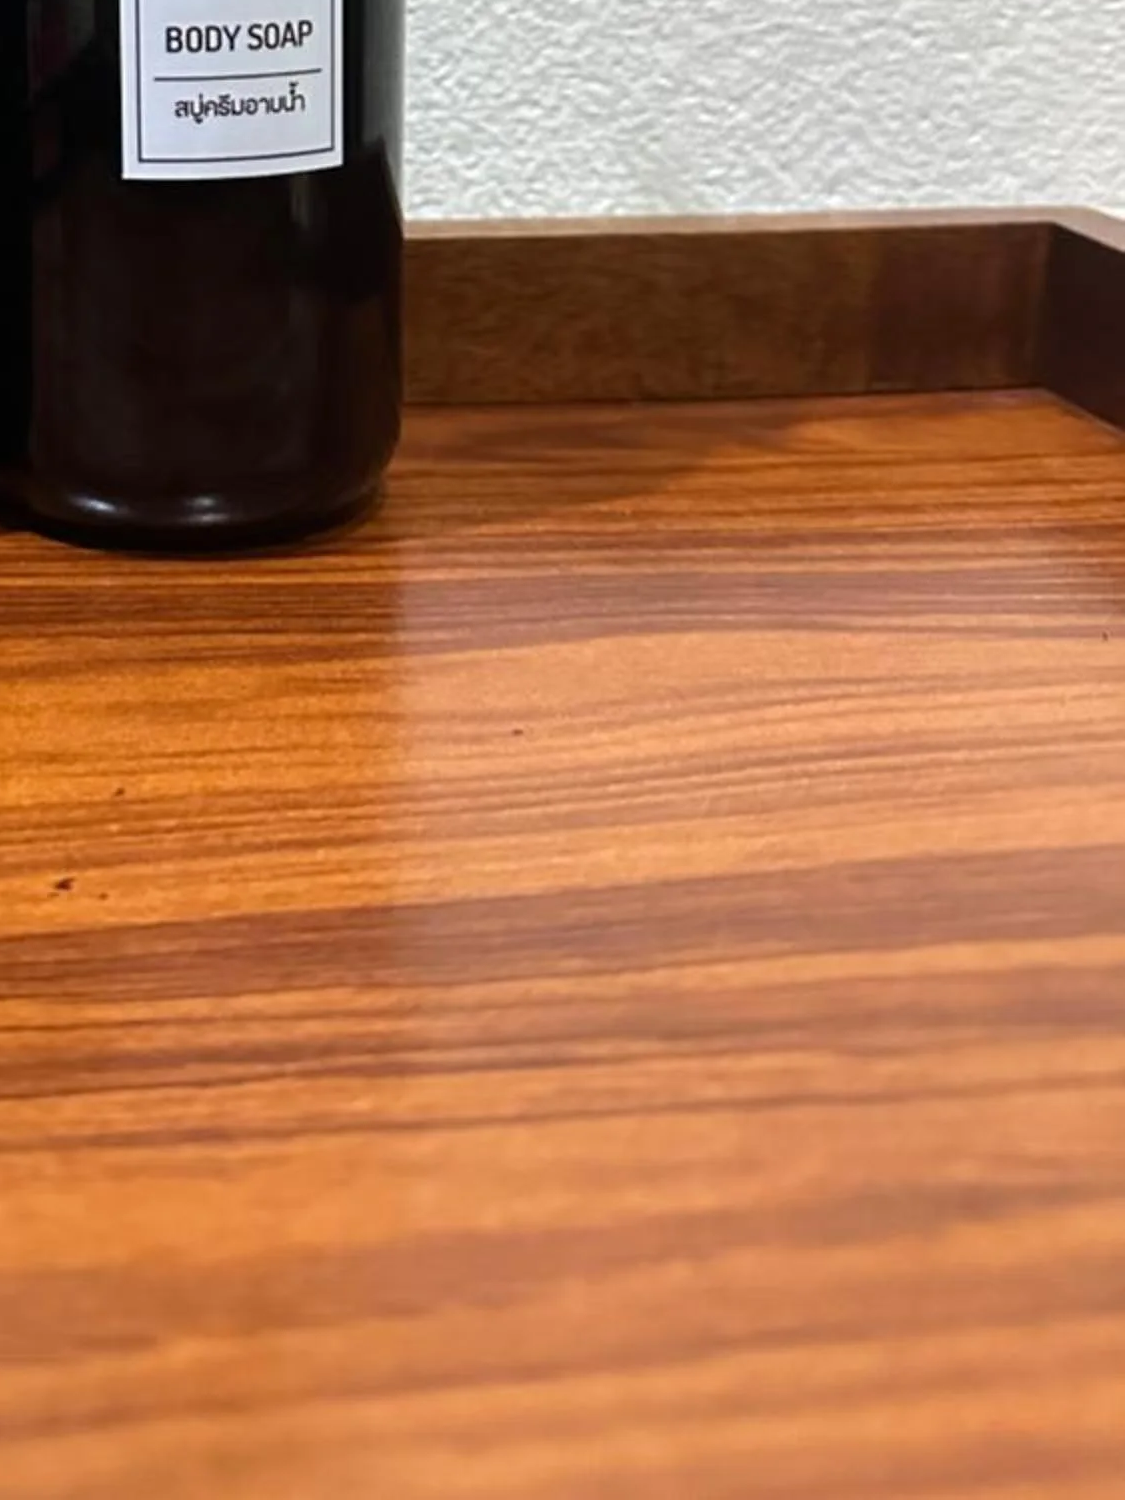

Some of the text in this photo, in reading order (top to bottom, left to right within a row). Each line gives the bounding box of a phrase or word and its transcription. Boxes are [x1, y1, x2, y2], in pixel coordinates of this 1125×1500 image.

[165, 19, 313, 53] BODY SOAP
[174, 81, 306, 124] สบู่ครีมอาบน้ำ
